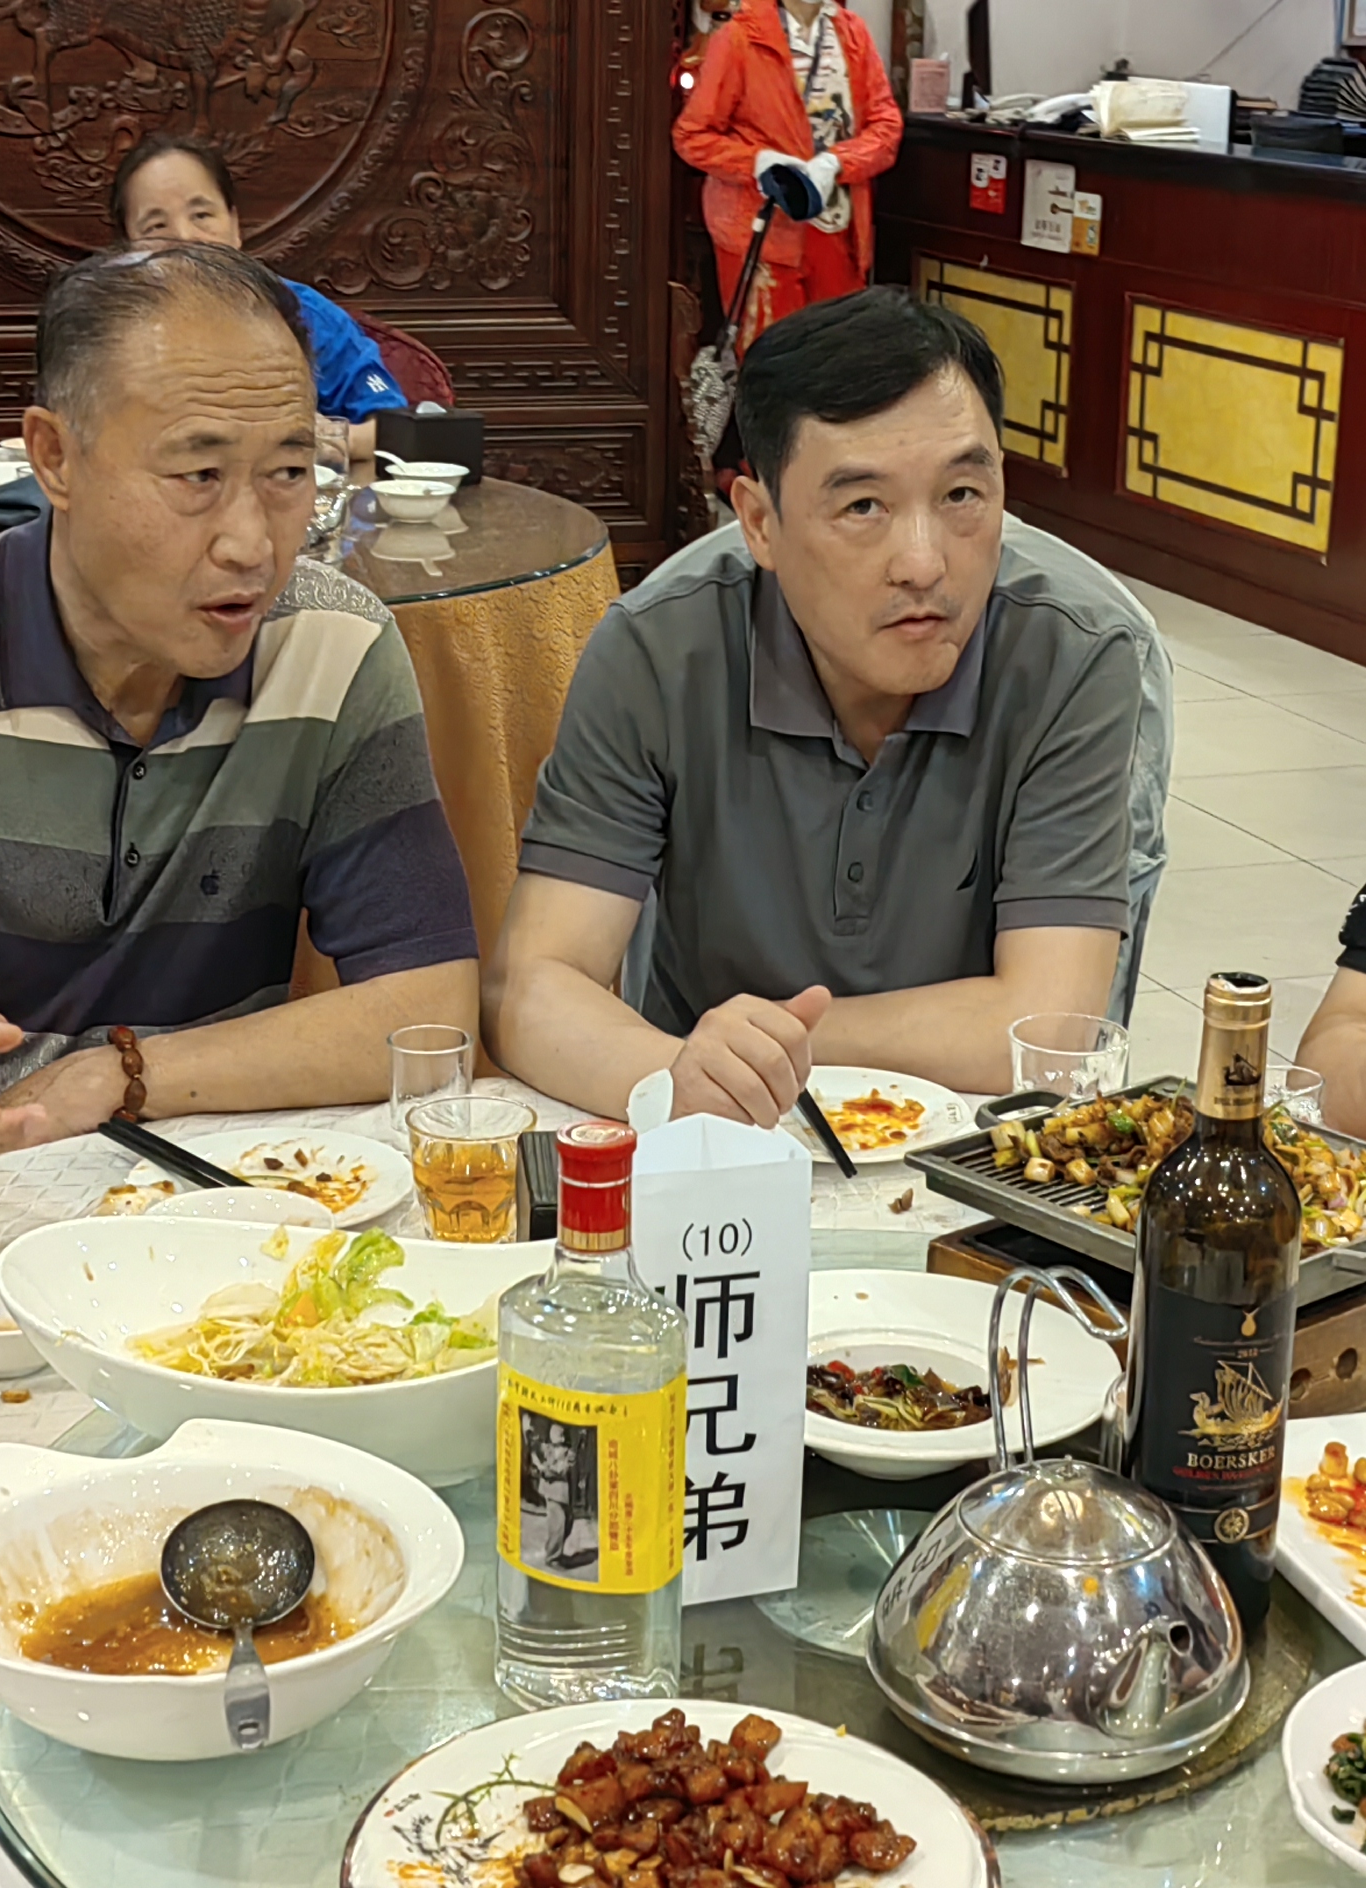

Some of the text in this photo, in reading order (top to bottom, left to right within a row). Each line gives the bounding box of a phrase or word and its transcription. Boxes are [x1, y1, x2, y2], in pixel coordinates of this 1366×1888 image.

[682, 1218, 753, 1261] (10)
[655, 1270, 761, 1561] 师兄弟
[1186, 1445, 1276, 1470] BOERSKER
